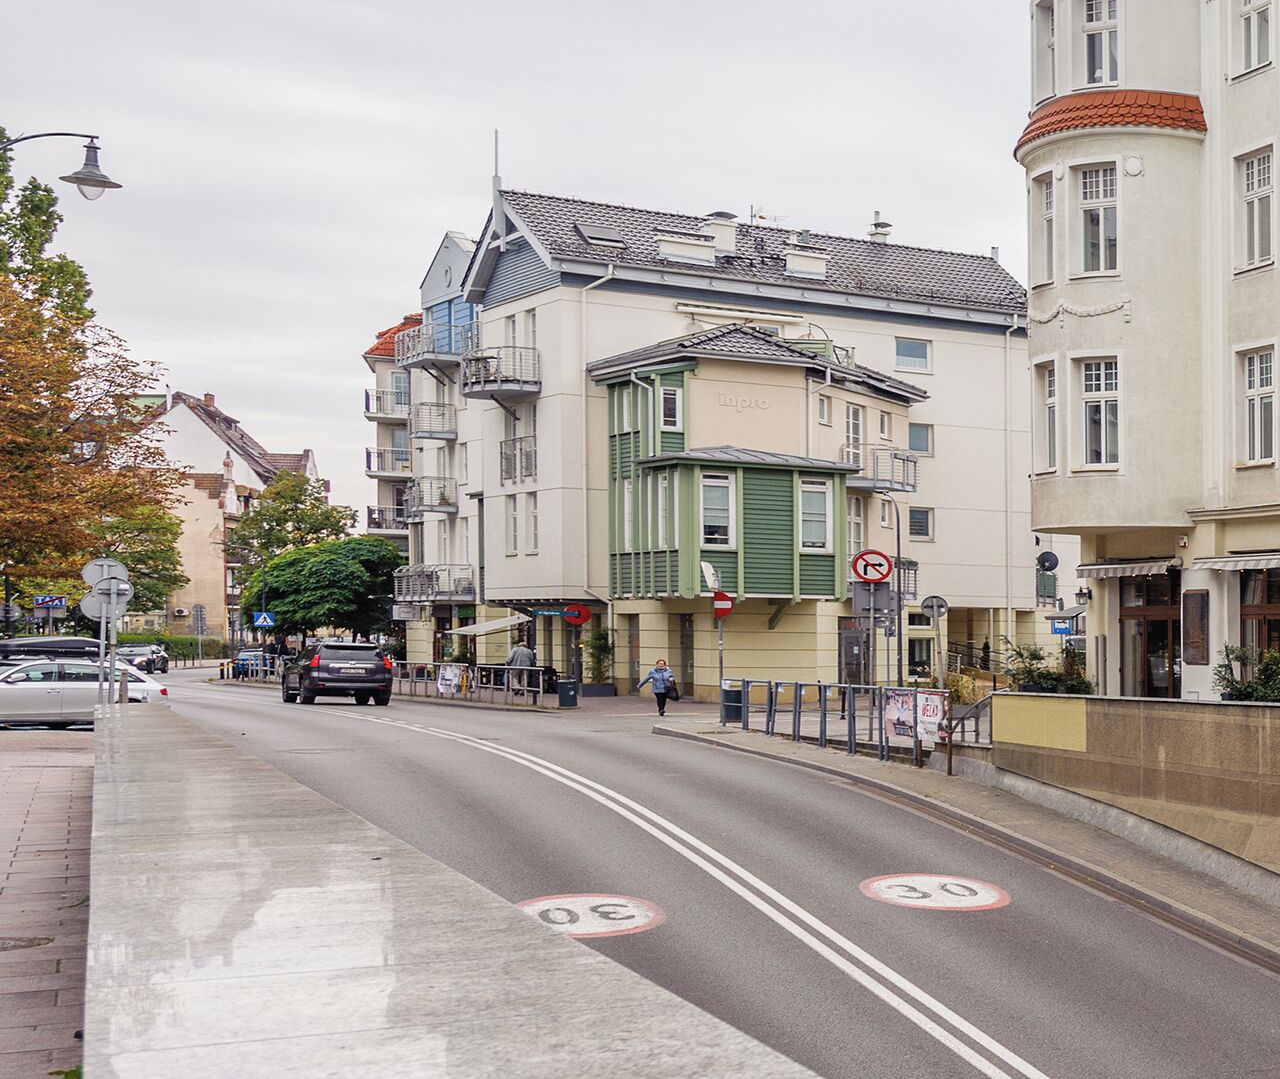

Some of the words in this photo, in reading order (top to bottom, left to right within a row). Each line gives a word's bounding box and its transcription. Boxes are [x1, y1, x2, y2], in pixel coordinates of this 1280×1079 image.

[719, 392, 770, 413] inpro
[36, 596, 65, 606] TAXI
[884, 883, 978, 899] 30
[538, 903, 636, 924] 30
